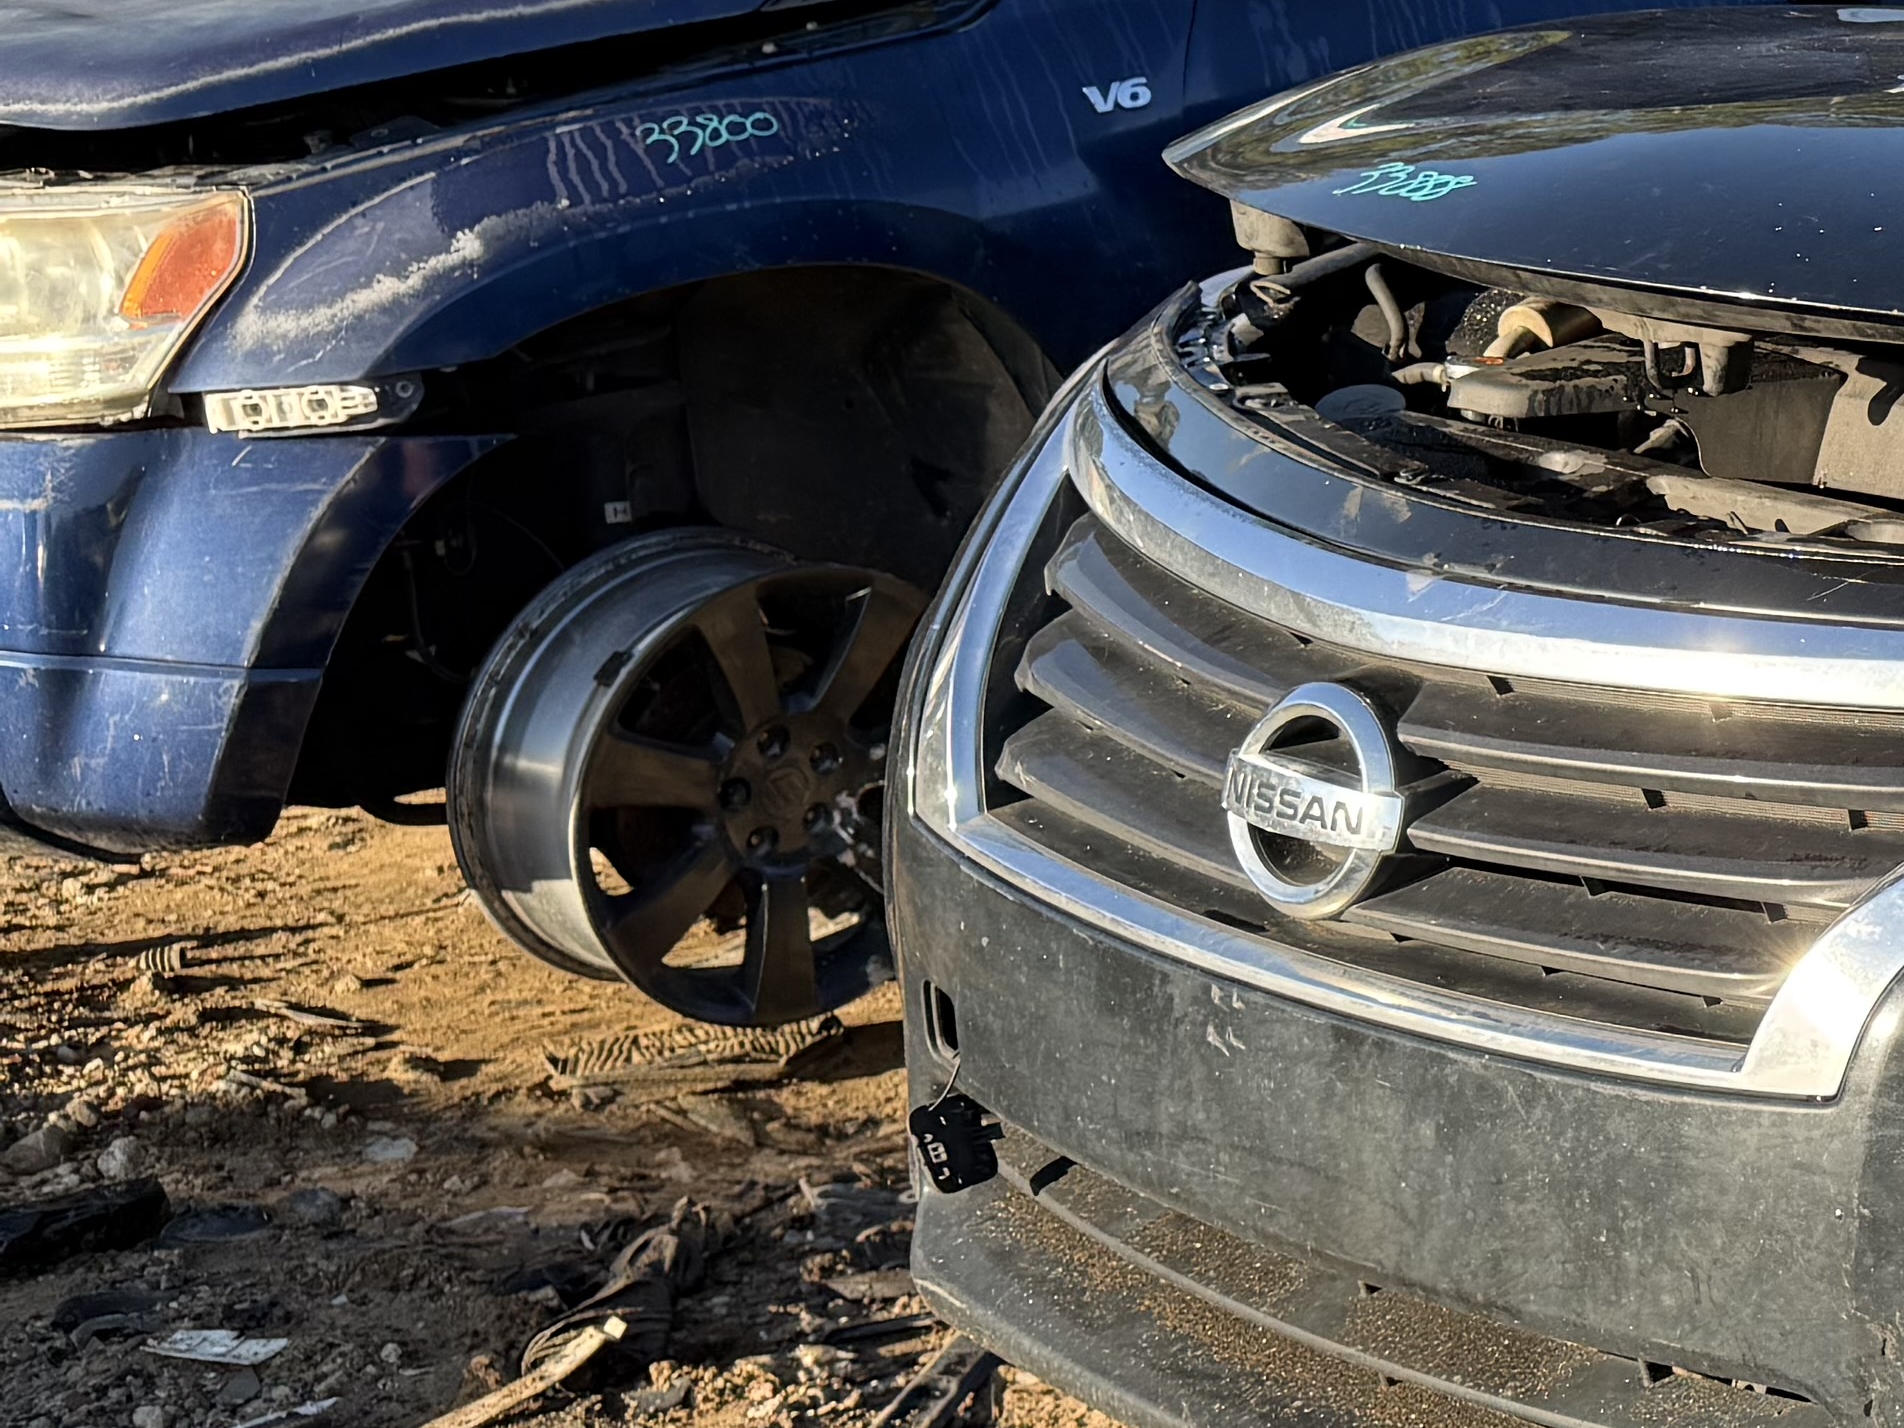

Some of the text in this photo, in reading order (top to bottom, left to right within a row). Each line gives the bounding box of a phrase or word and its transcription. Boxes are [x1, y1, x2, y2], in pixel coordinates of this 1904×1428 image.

[1082, 76, 1152, 113] V6
[635, 111, 779, 164] 33800
[1226, 766, 1364, 835] NISSAN
